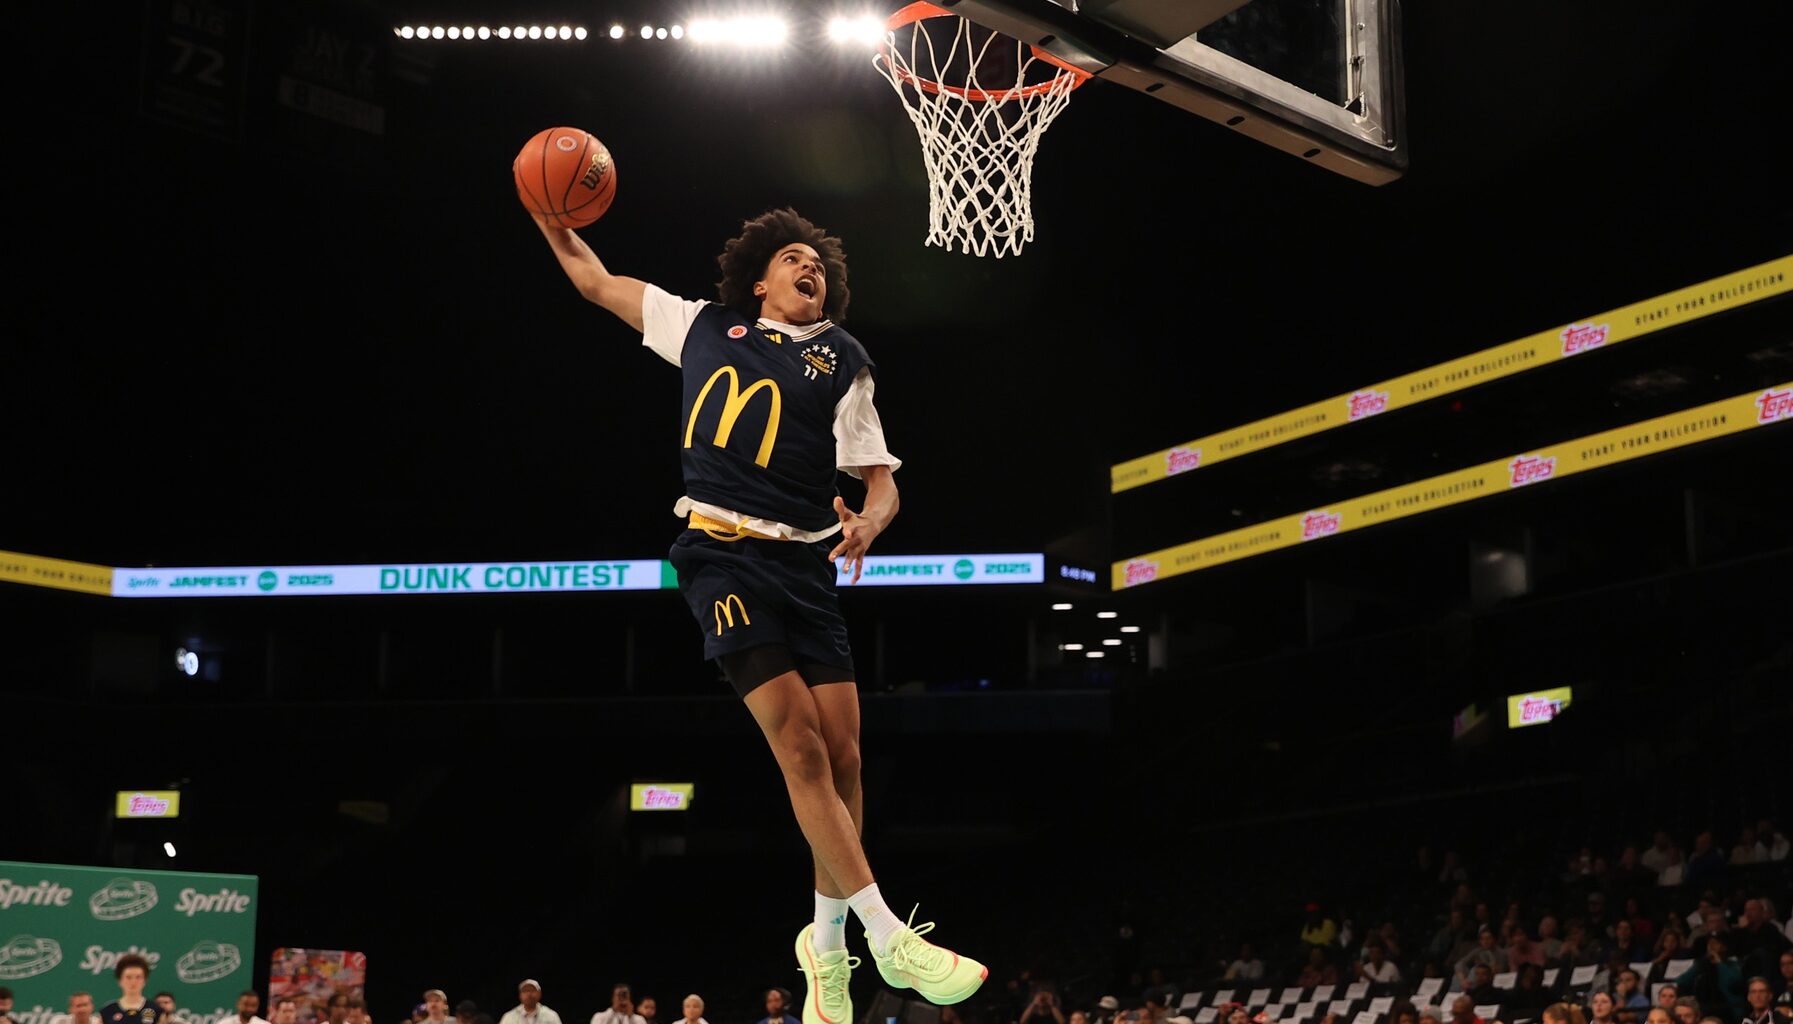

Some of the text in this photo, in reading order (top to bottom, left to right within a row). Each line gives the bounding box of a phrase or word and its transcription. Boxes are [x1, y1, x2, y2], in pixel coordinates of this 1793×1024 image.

[167, 34, 225, 88] 72
[1634, 271, 1784, 326] START YOUR COLLECTION
[1473, 349, 1536, 376] COLLECTION
[1581, 413, 1727, 461] START YOUR COLLECTION
[169, 575, 249, 588] JAMFEST
[286, 574, 333, 586] 2025
[379, 564, 631, 590] DUNK CONTEST
[864, 563, 946, 577] JAMFEST
[984, 562, 1032, 575] 2025
[174, 887, 251, 917] Sprite
